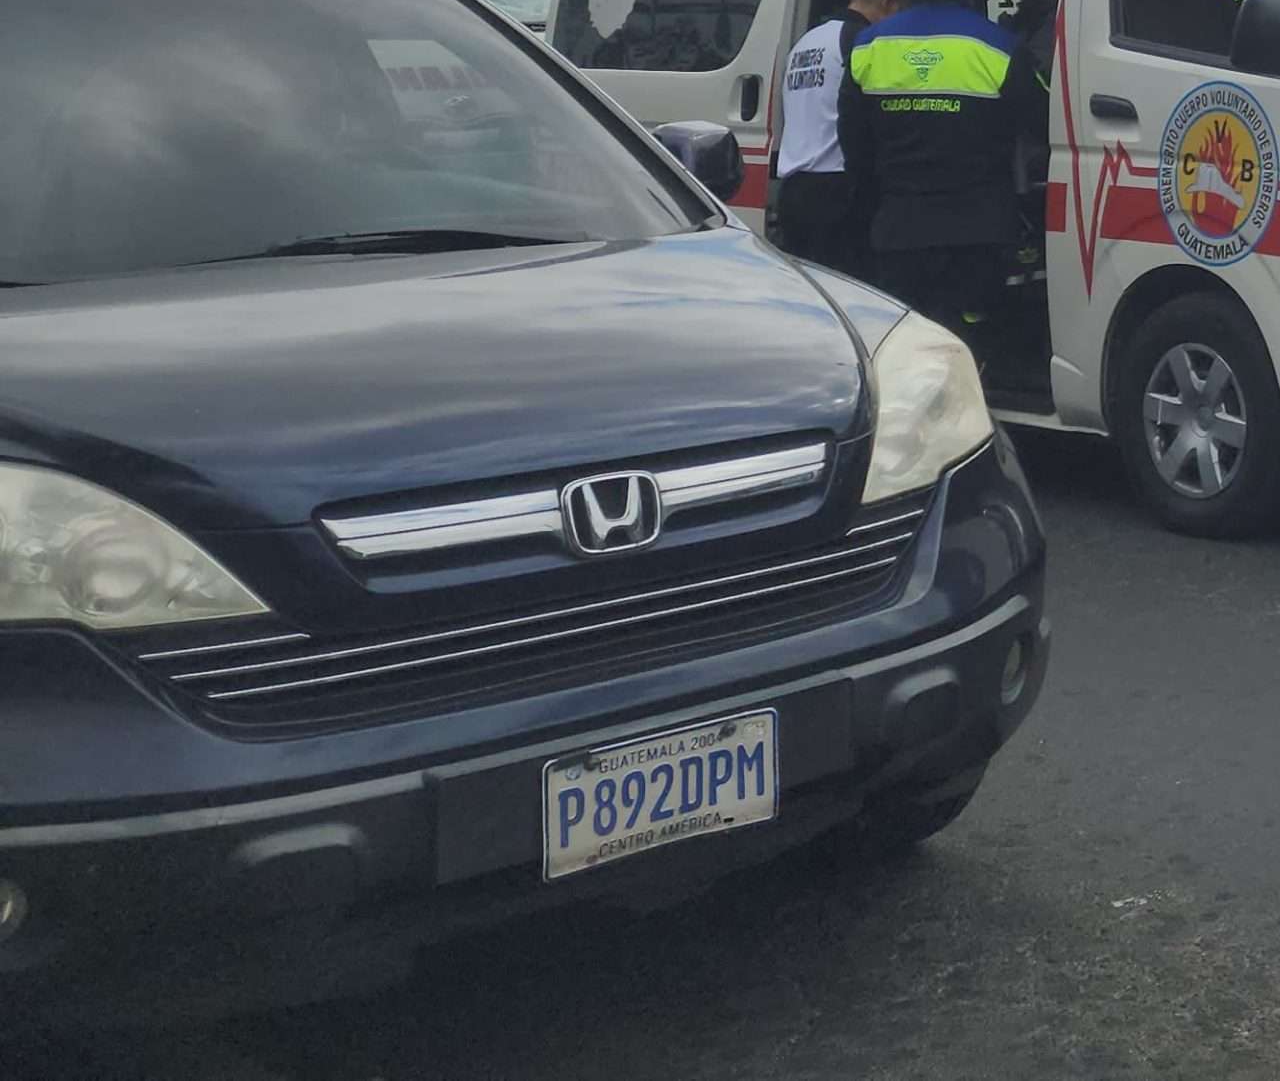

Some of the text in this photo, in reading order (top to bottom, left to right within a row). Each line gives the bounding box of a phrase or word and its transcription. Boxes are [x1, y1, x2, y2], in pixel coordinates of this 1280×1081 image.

[1214, 117, 1228, 144] V
[1160, 90, 1274, 229] BENEMERITO CUERPO VOLUNTARIO DE BOMBEROS
[1183, 152, 1255, 183] C B
[1177, 222, 1249, 260] GUATEMALA
[600, 740, 685, 774] GUATEMALA
[558, 741, 765, 849] P892DPM
[600, 828, 655, 858] CENTRO
